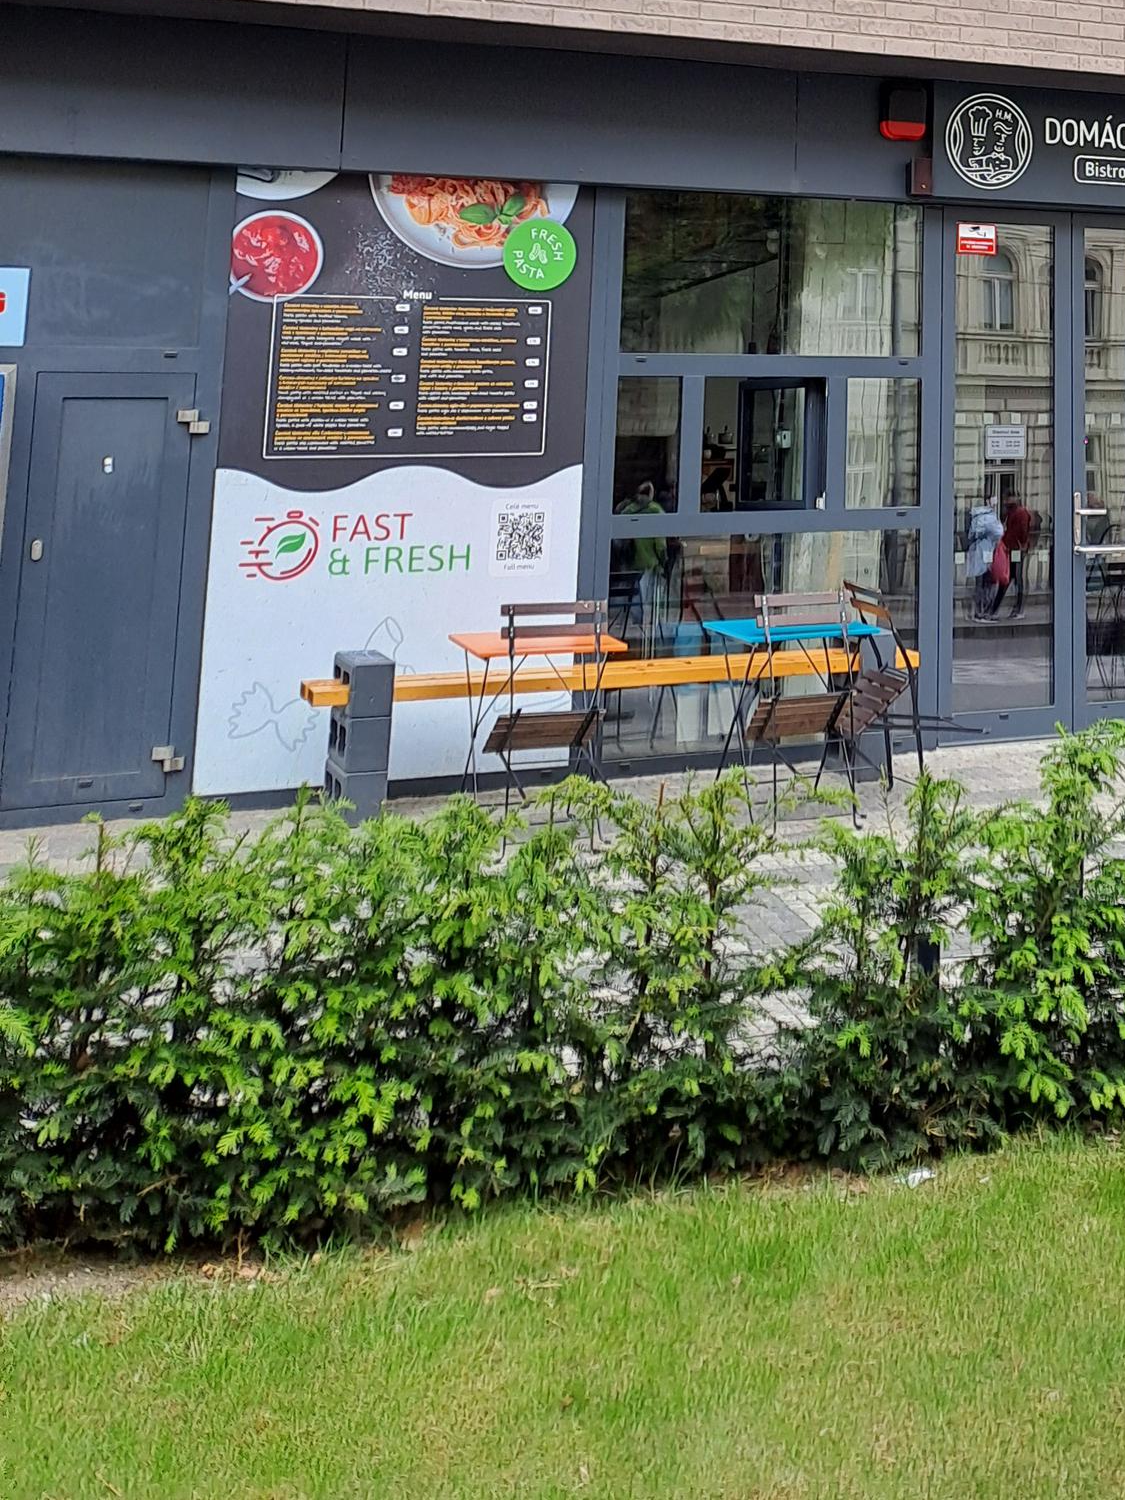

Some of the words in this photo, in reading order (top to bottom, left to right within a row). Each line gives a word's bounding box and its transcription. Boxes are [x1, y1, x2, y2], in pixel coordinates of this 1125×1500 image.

[531, 228, 564, 261] FRESH
[512, 250, 545, 279] PASTA
[403, 290, 432, 300] Menu
[331, 512, 414, 543] FAST
[328, 548, 350, 576] &
[364, 544, 472, 575] FRESH
